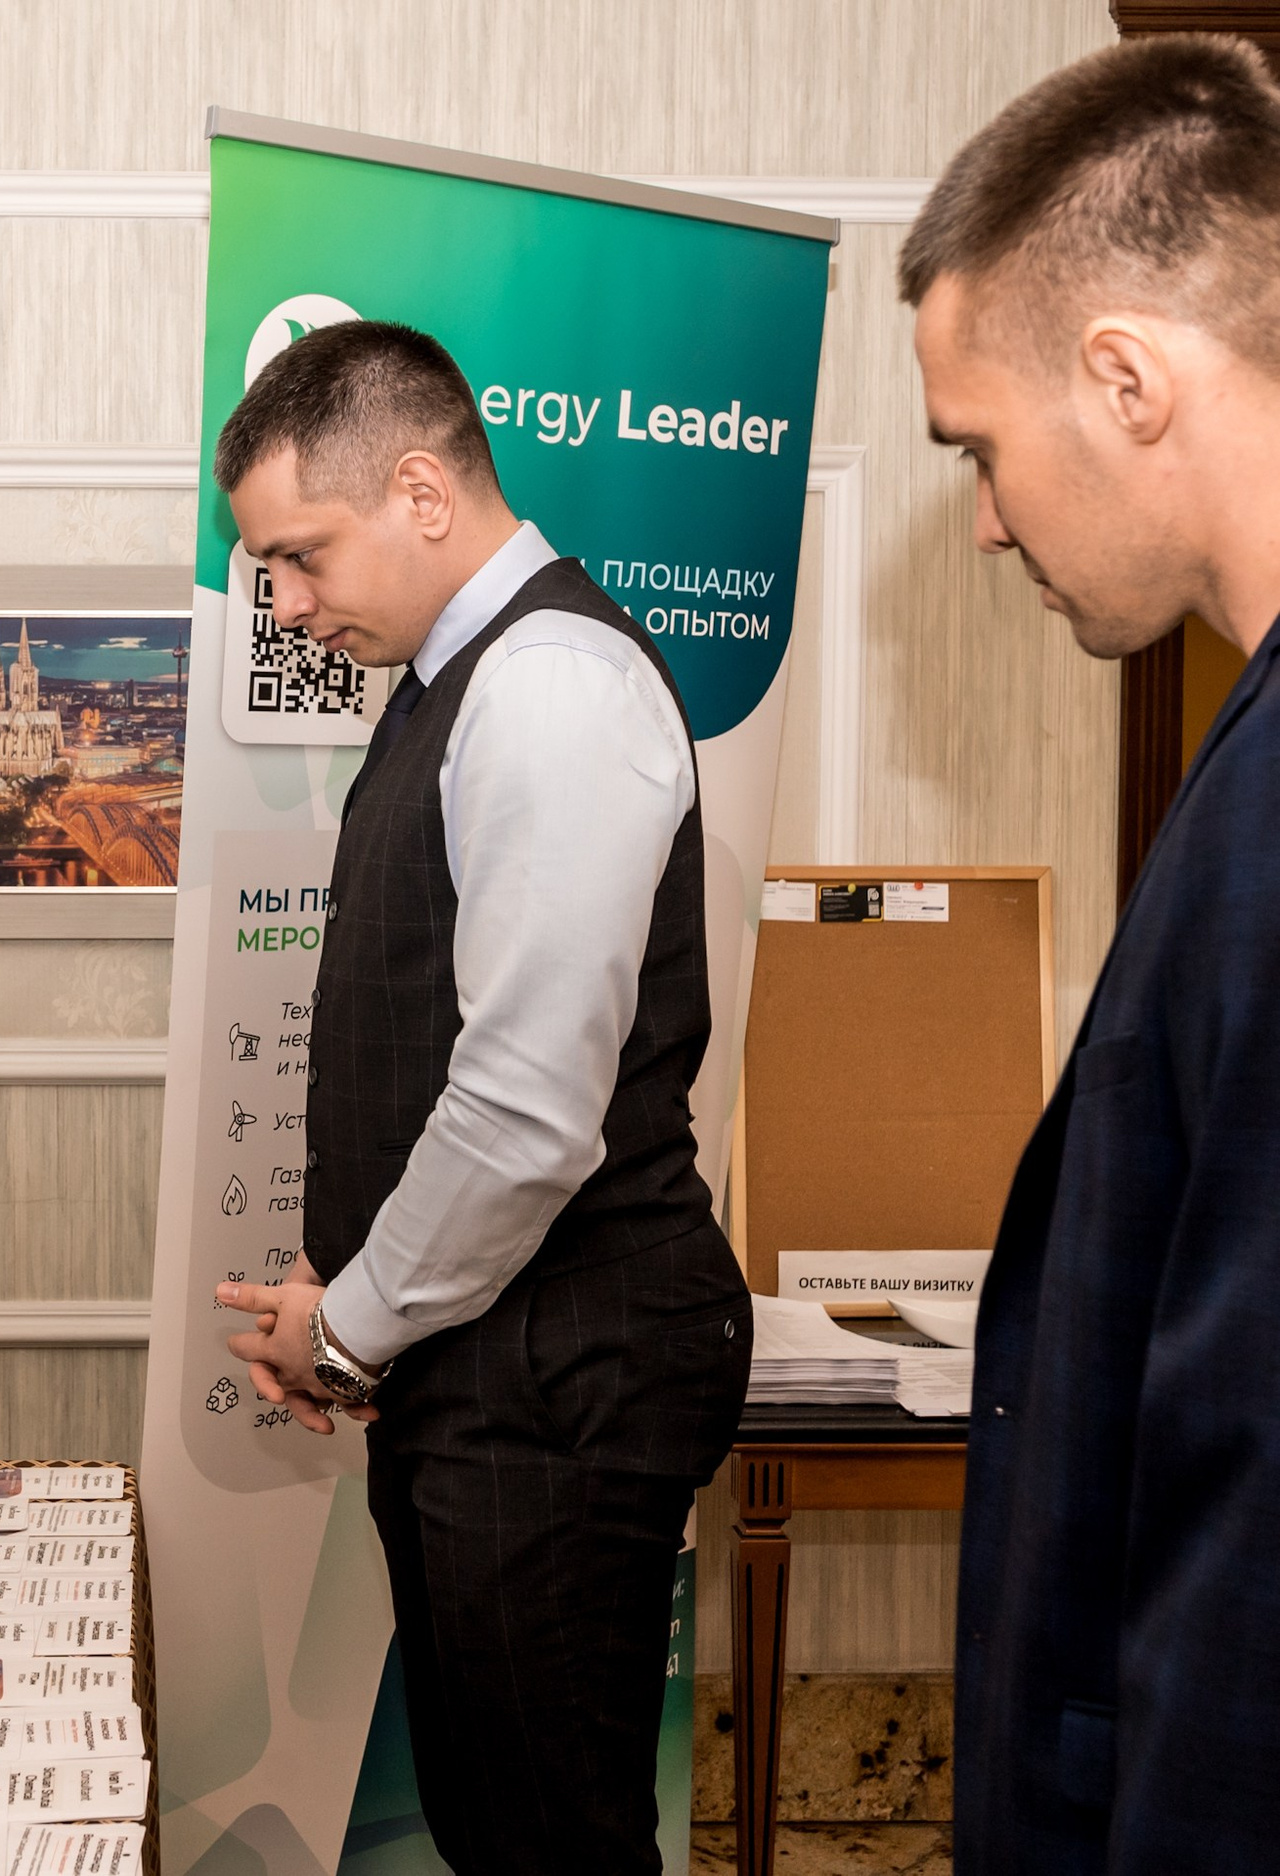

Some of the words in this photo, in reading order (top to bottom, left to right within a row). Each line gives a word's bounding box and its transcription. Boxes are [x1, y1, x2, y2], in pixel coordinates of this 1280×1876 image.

[617, 389, 789, 456] Leader
[602, 559, 775, 600] ПЛОЩАДКУ
[645, 607, 771, 640] ОПЫТОМ
[239, 888, 289, 914] МЫ
[237, 925, 321, 952] МЕРО
[276, 1062, 289, 1076] и
[799, 1277, 866, 1290] ОСТАВЬТЕ
[870, 1278, 910, 1291] ВАШУ
[913, 1279, 974, 1292] ВИЗИТКУ
[23, 1775, 37, 1800] Chemical
[80, 1770, 93, 1801] Consultant
